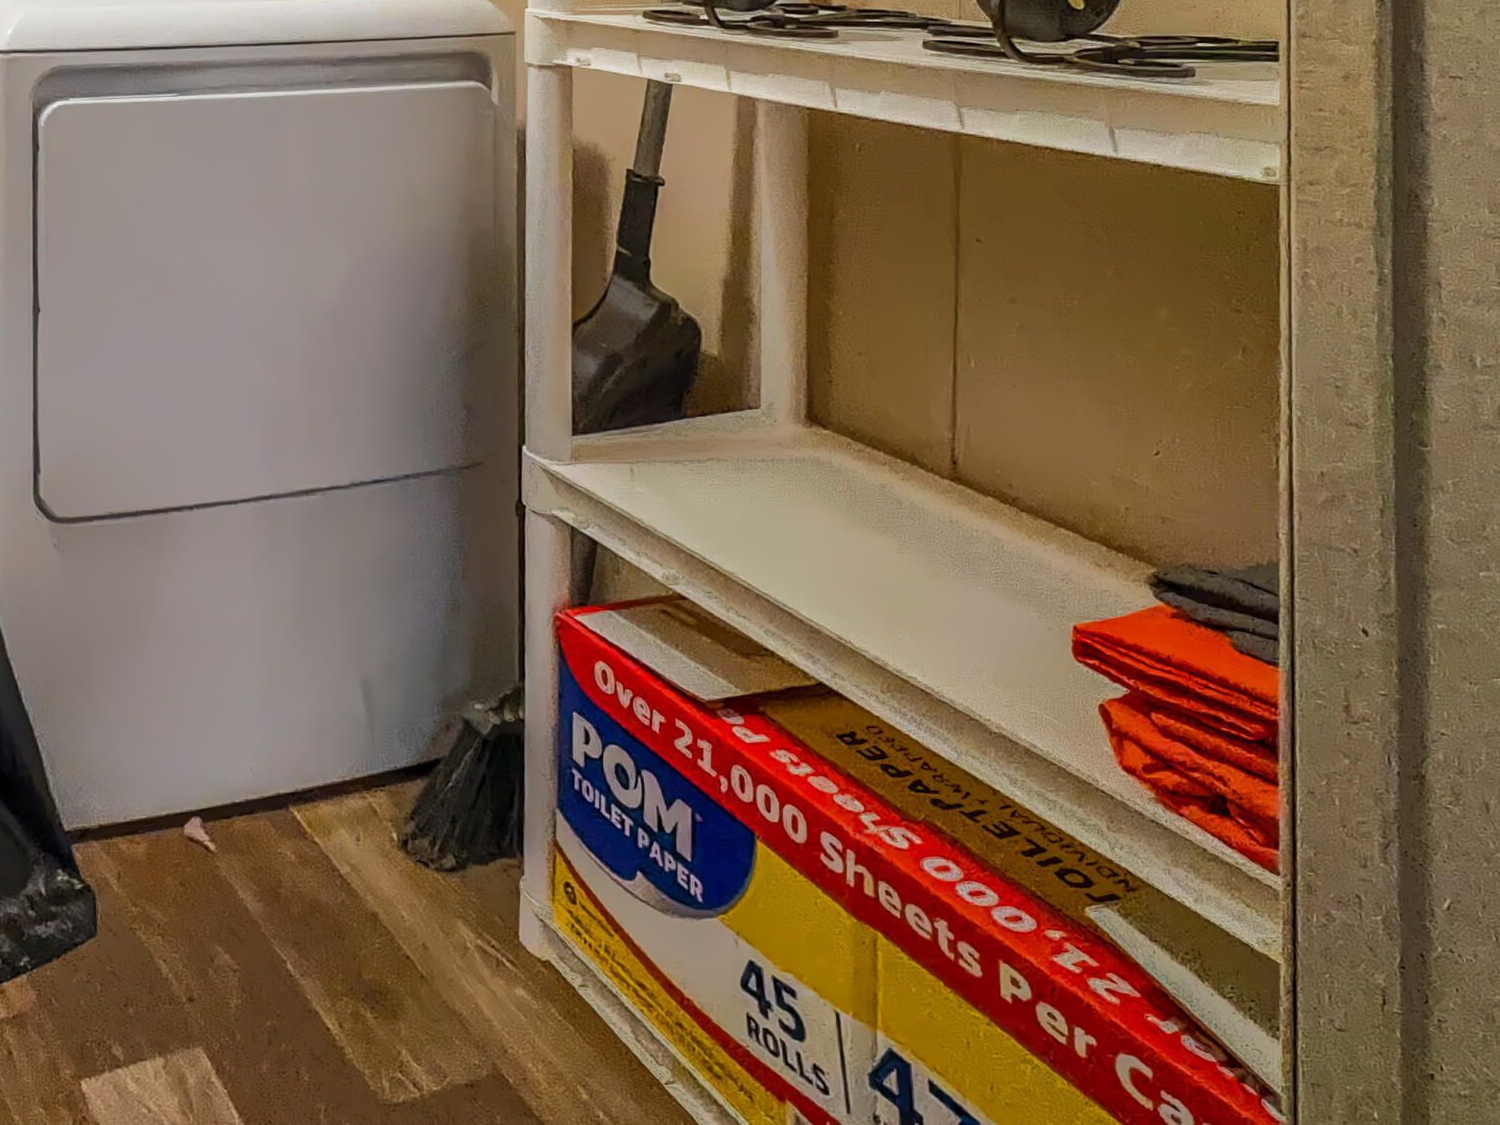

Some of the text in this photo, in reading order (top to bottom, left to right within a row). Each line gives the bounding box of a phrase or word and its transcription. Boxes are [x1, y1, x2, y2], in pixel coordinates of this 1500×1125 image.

[571, 768, 704, 903] TOILET PAPER
[572, 711, 693, 863] POM
[770, 749, 922, 849] Sheets
[836, 731, 1121, 903] TOILET PAPER
[594, 661, 1196, 1125] Over 21,000 Sheets Per Ca
[740, 960, 806, 1042] 45
[746, 1012, 830, 1096] ROLLS
